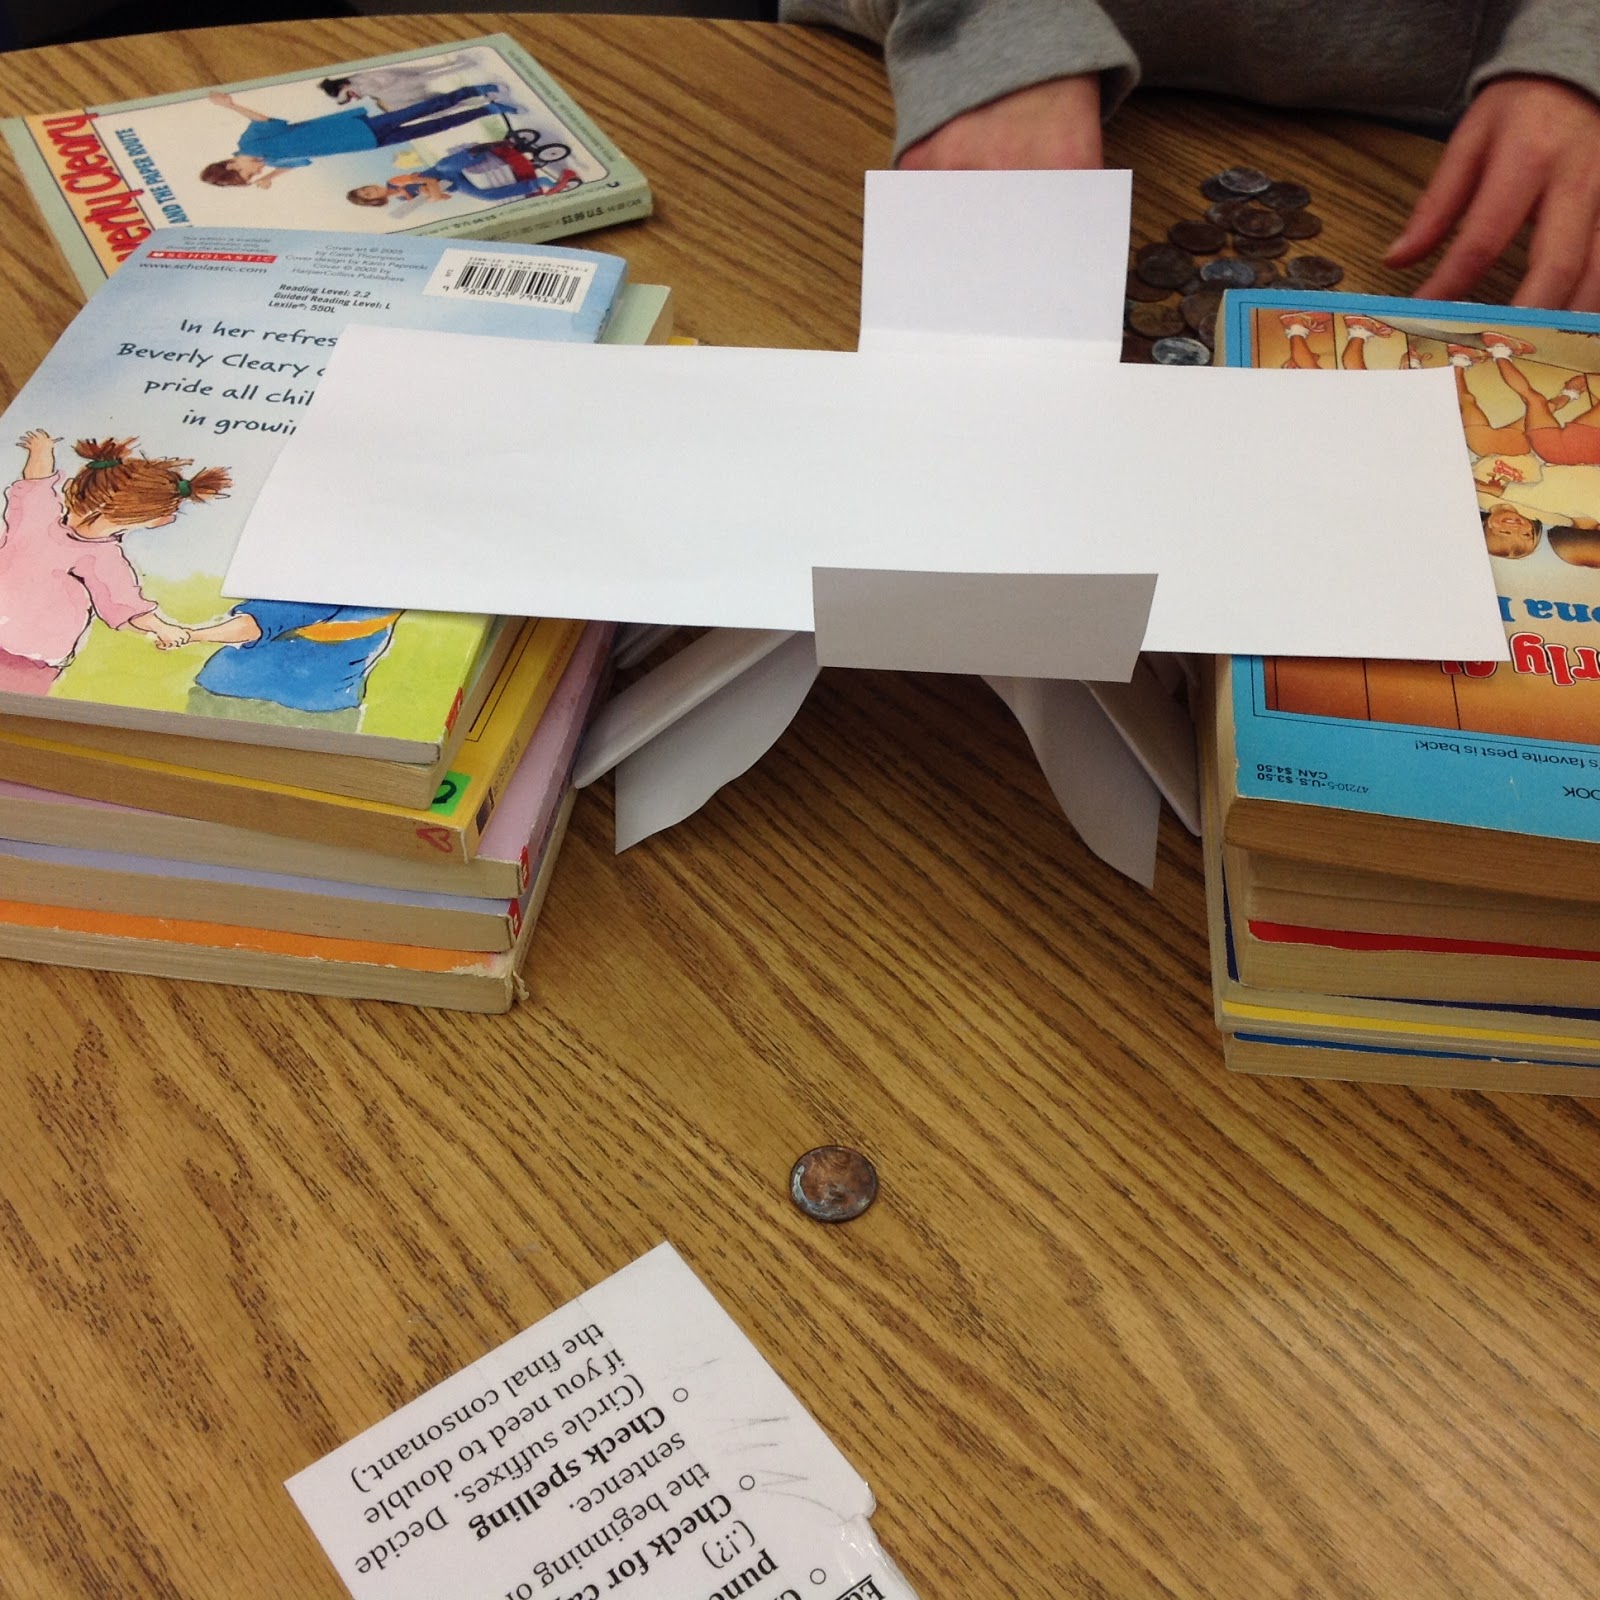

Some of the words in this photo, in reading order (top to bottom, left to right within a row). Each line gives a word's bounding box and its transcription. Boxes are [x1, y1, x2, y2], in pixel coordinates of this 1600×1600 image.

[42, 112, 124, 194] Cleary
[115, 128, 147, 157] ROUTE
[133, 156, 165, 185] PAPER
[149, 184, 176, 205] THE
[161, 204, 190, 224] AND
[139, 262, 268, 274] www.scholastic.com
[166, 252, 274, 264] SCHOLASTIC
[273, 292, 309, 301] Guided
[310, 295, 351, 307] Reading
[352, 299, 382, 309] Level:
[279, 283, 319, 294] Reading
[321, 287, 350, 297] Level:
[353, 290, 371, 298] 2.2
[310, 304, 336, 314] 550L
[180, 318, 203, 333] In
[212, 320, 255, 339] her
[117, 341, 214, 368] Beverly
[221, 353, 310, 378] Cleary
[144, 378, 214, 396] pride
[222, 383, 259, 400] all
[182, 409, 206, 426] in
[1414, 739, 1461, 755] back!
[1463, 744, 1478, 754] is
[1481, 747, 1518, 760] pest
[1521, 751, 1586, 769] favorite
[1256, 763, 1293, 775] $4.50
[1256, 771, 1294, 784] $3.50
[561, 1322, 605, 1355] the
[502, 1349, 562, 1398] final
[602, 1348, 626, 1376] if
[553, 1357, 603, 1401] you
[560, 1373, 645, 1436] (Circle
[487, 1395, 553, 1448] need
[582, 1406, 666, 1466] Check
[350, 1388, 500, 1494] consonant.)
[458, 1438, 488, 1463] to
[453, 1431, 559, 1503] suffixes.
[569, 1432, 686, 1513] sentence.
[665, 1462, 711, 1497] the
[363, 1458, 453, 1524] double
[468, 1458, 582, 1541] spelling
[354, 1505, 450, 1575] Decide
[532, 1492, 671, 1588] beginning
[646, 1493, 733, 1558] Check
[606, 1549, 650, 1590] for
